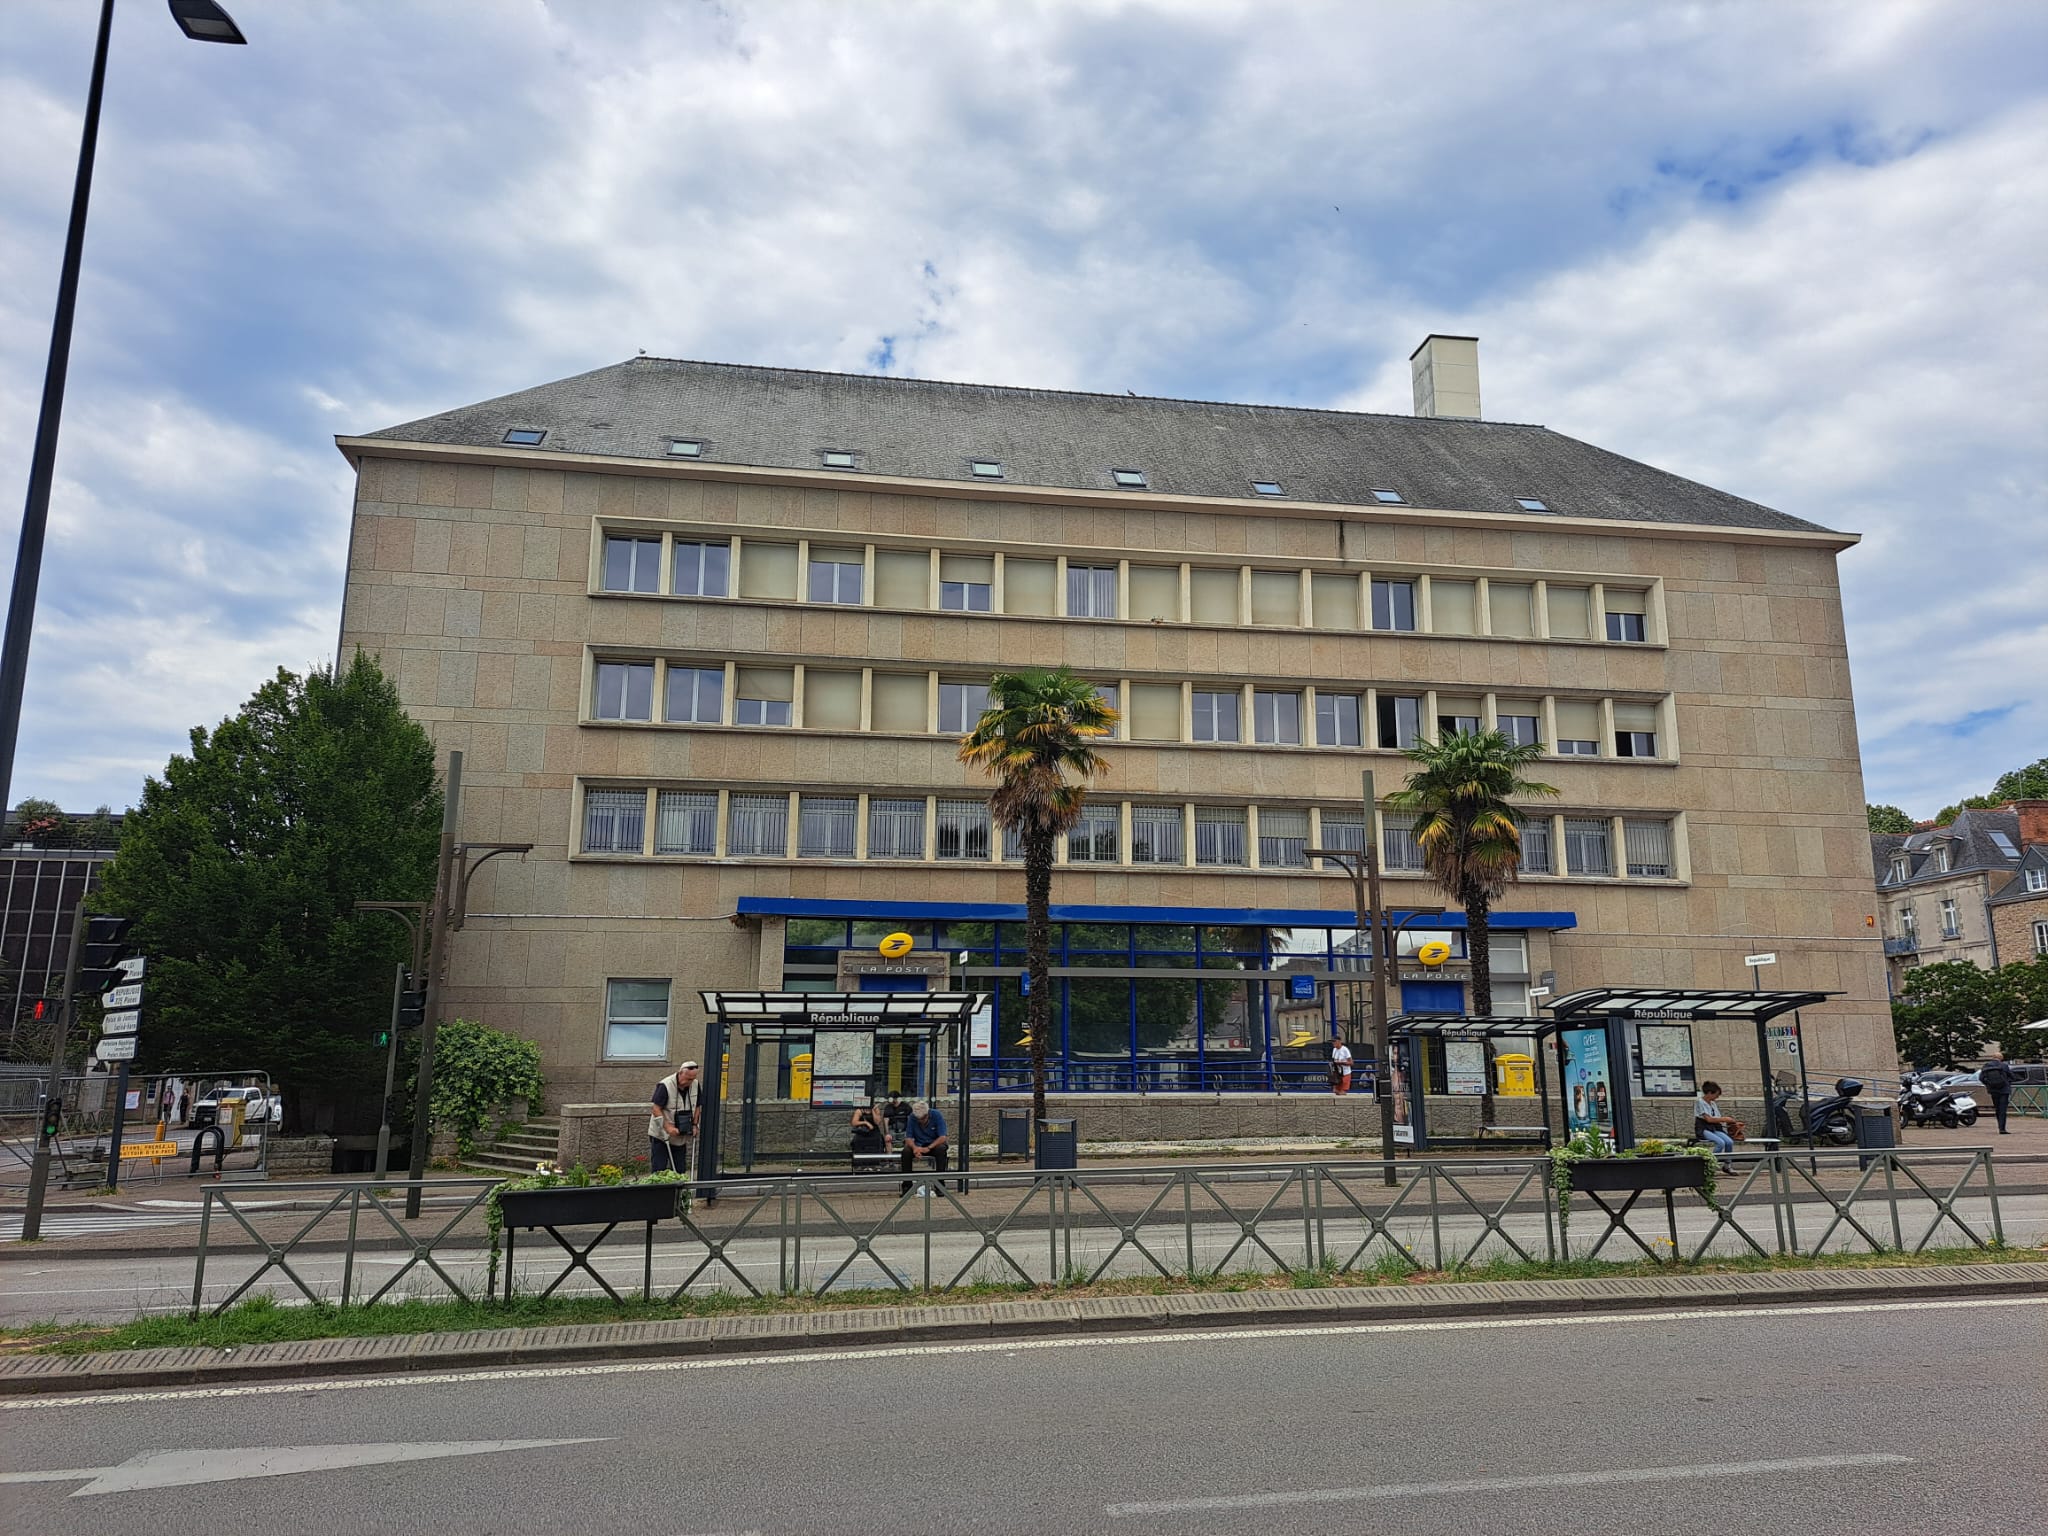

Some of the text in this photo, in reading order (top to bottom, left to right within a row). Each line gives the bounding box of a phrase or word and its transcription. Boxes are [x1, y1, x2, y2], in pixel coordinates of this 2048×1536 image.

[811, 1013, 880, 1025] République
[1634, 1009, 1693, 1019] République
[1441, 1029, 1487, 1038] République
[1788, 1041, 1797, 1053] C
